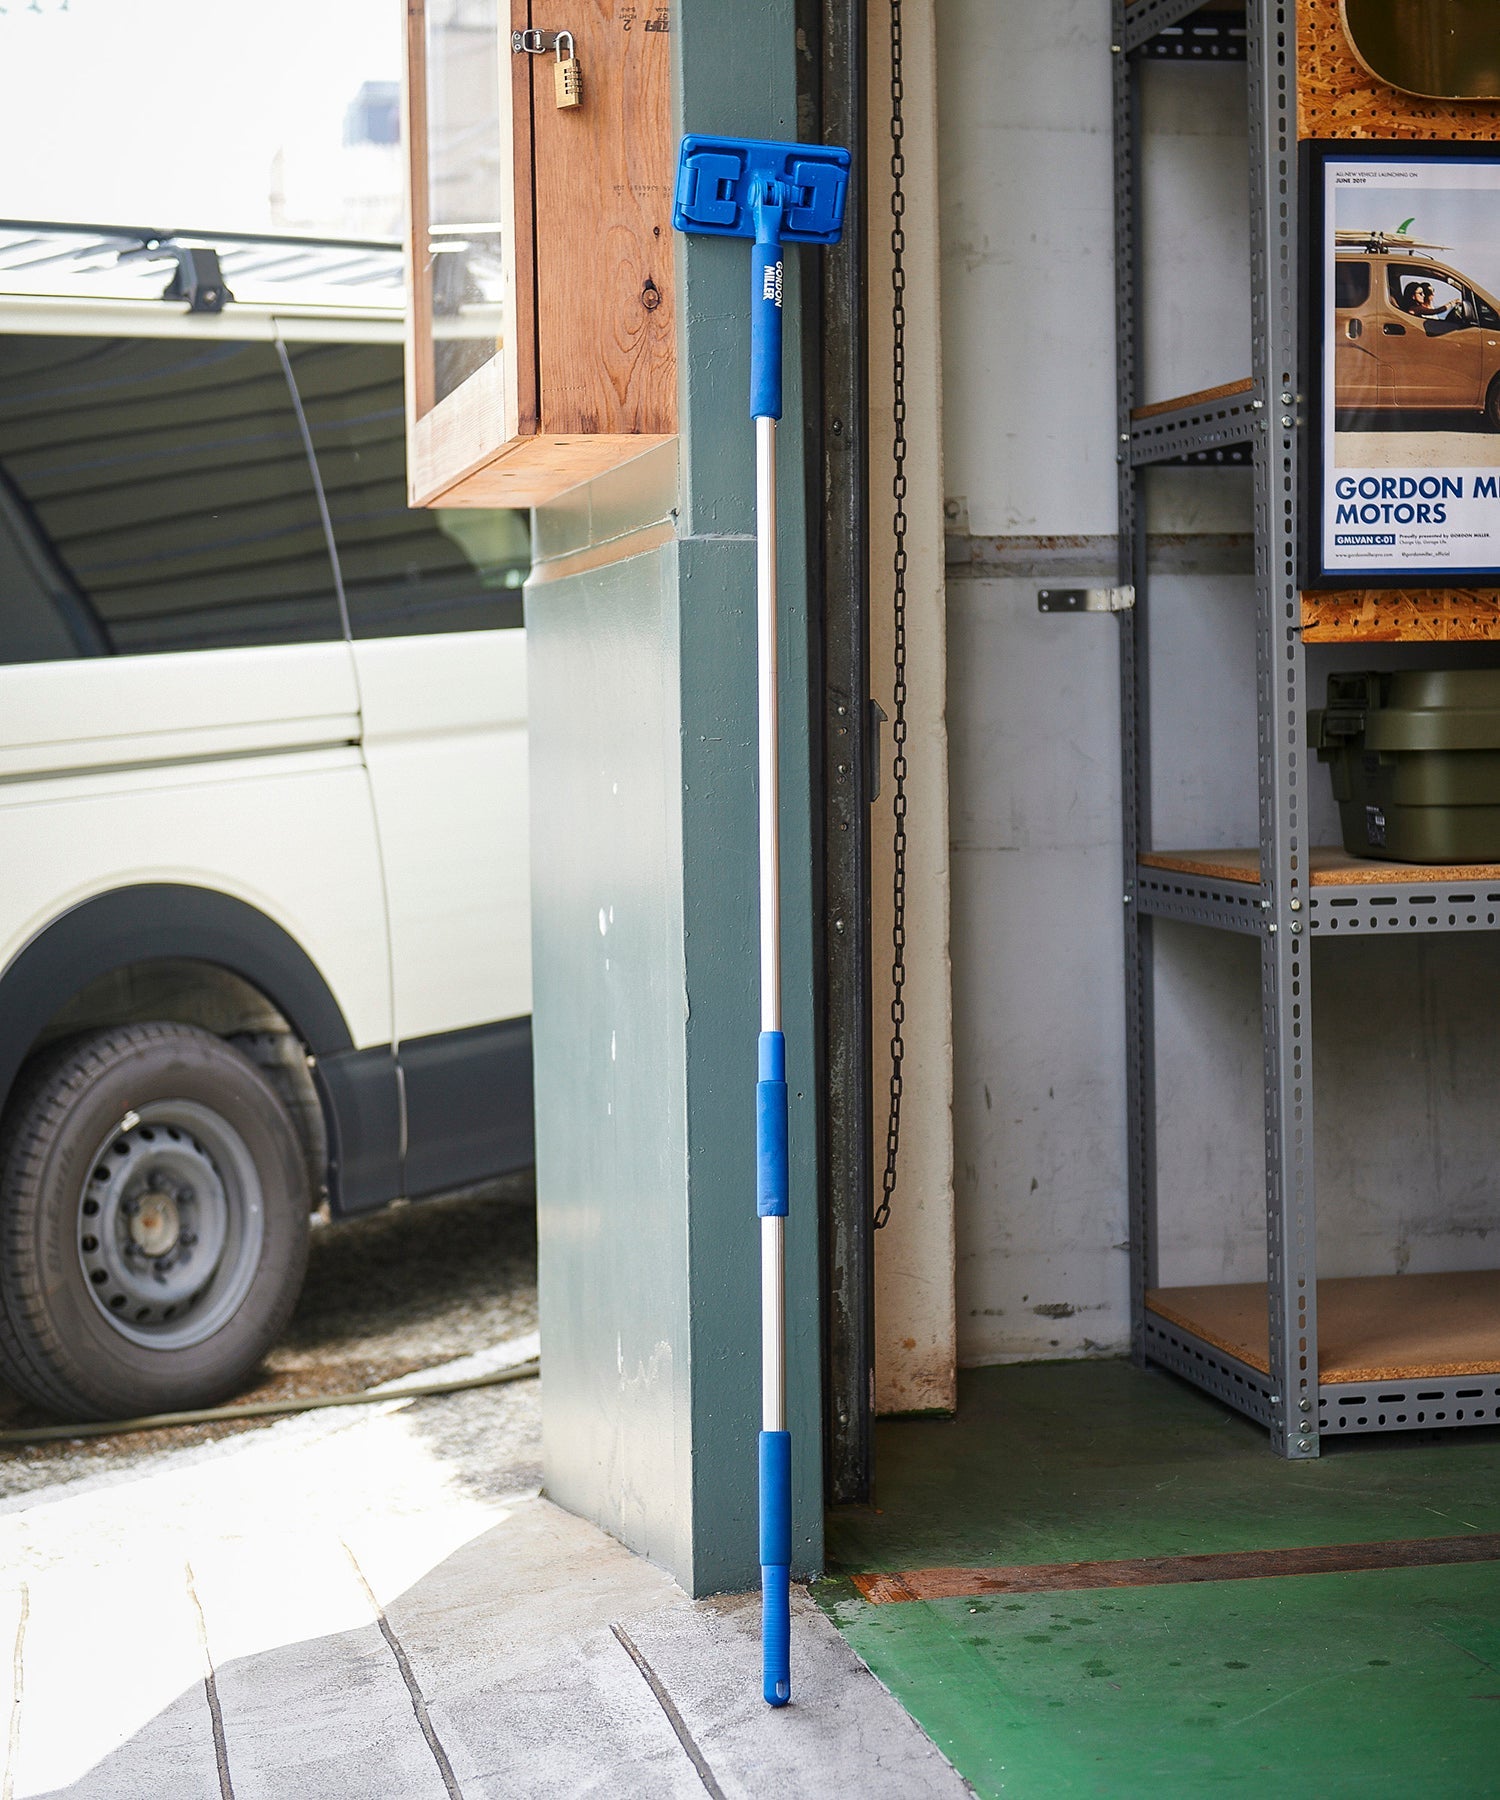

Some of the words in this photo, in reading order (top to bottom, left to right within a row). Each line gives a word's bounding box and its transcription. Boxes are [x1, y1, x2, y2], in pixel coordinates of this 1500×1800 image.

[623, 19, 632, 31] 2
[763, 265, 776, 301] MILLER
[775, 261, 783, 308] GORDON
[1335, 477, 1463, 499] GORDON
[1473, 477, 1500, 498] M
[1335, 503, 1447, 525] MOTORS
[1337, 536, 1373, 544] GMLVAN
[1375, 535, 1393, 544] C-01
